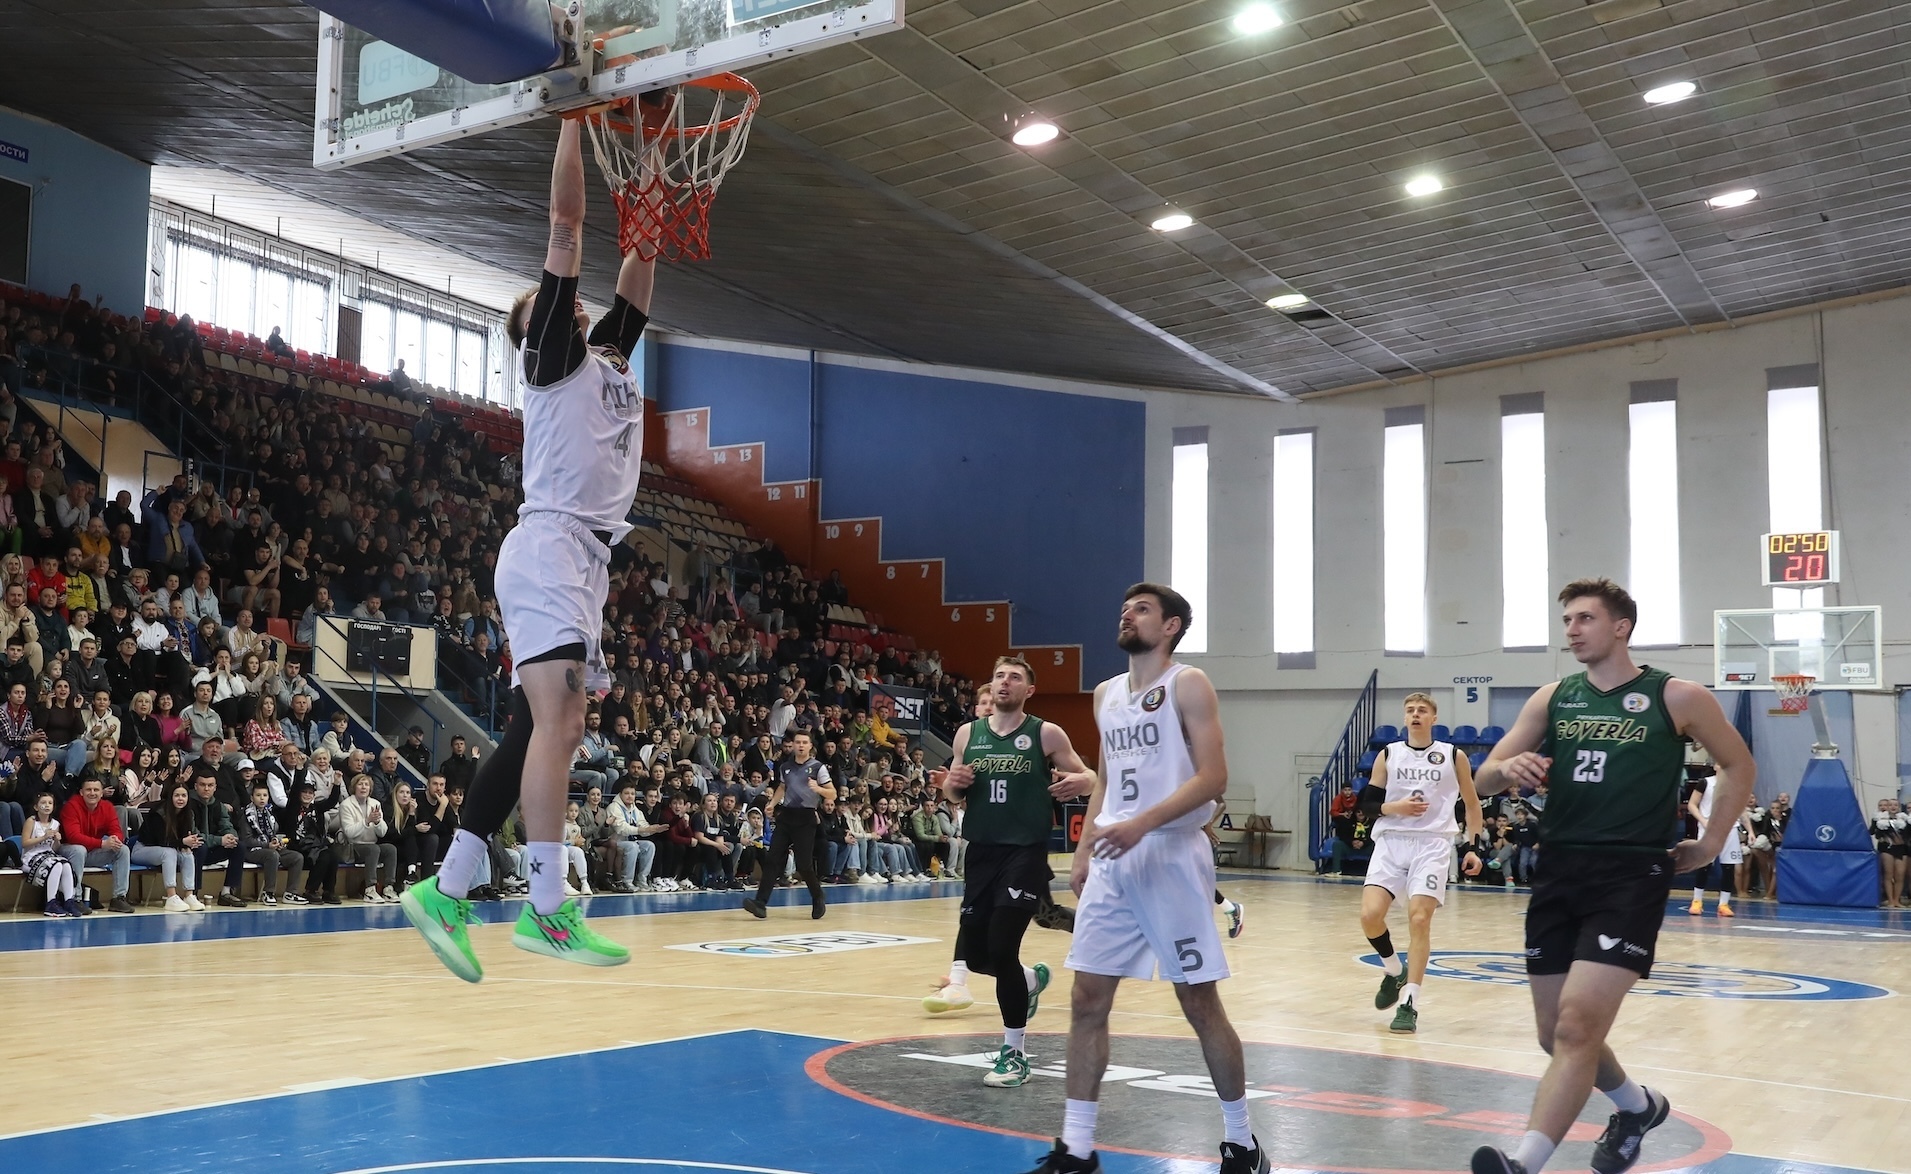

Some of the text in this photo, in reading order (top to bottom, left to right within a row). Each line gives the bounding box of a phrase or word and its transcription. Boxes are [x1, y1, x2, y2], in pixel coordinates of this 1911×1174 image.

[686, 414, 698, 426] 15
[713, 449, 752, 464] 14 13
[767, 486, 806, 501] 12 11
[825, 523, 864, 539] 10 9
[886, 564, 929, 580] 8 7
[1784, 554, 1824, 581] 20
[951, 608, 995, 622] 6 5
[1053, 651, 1064, 665] 3
[1453, 676, 1493, 684] СЕКТОР
[1467, 687, 1479, 703] 5
[1105, 722, 1160, 753] NIKO
[1556, 719, 1648, 746] GOVERLA
[971, 755, 1032, 777] GOVERLA
[1573, 749, 1608, 783] 23
[1397, 767, 1441, 782] NIKO
[989, 779, 1007, 803] 16
[1121, 768, 1139, 802] 5
[1425, 873, 1438, 891] 6
[1174, 936, 1204, 973] 5
